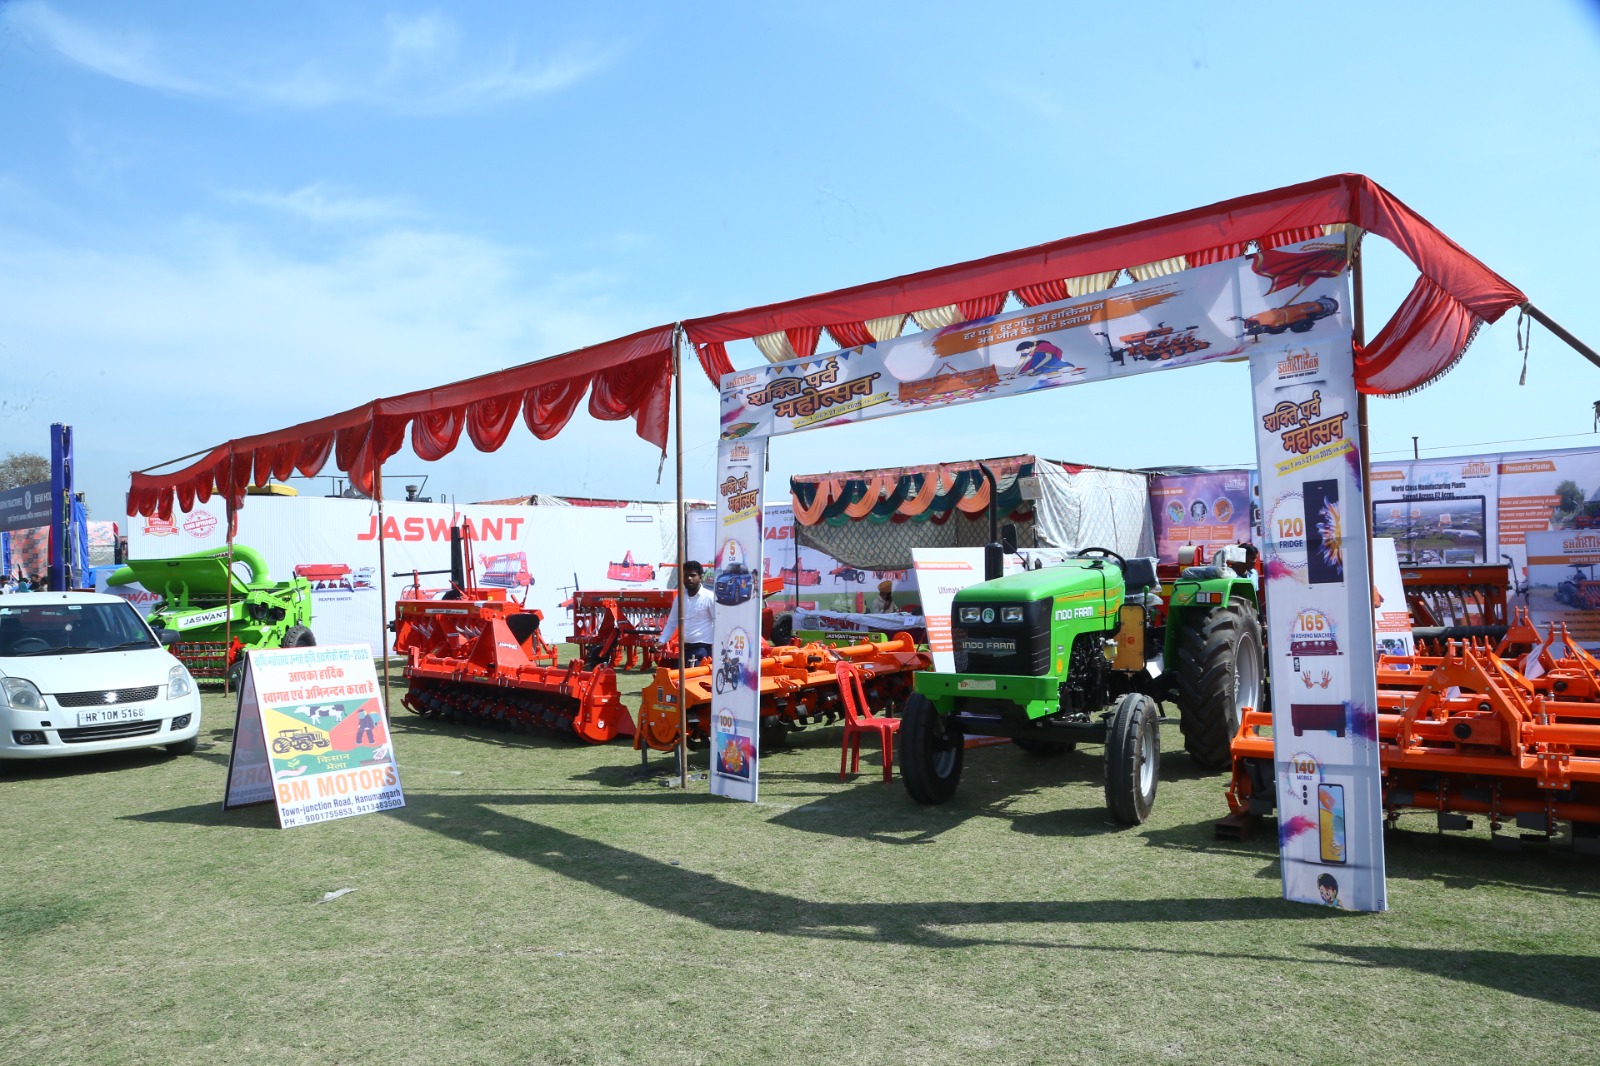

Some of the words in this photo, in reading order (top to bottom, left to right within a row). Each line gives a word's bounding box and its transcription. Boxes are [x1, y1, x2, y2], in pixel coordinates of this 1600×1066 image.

[964, 332, 976, 340] हर
[999, 323, 1012, 332] हर
[1039, 313, 1050, 322] में
[978, 335, 994, 344] अब
[1021, 326, 1034, 335] ढेर
[1060, 313, 1092, 327] इनाम
[1278, 354, 1319, 373] SHAKTIMAN
[748, 378, 802, 407] शक्ति
[805, 361, 839, 388] पर्व
[1263, 401, 1299, 432] शक्ति
[1299, 390, 1321, 419] पर्व
[1320, 449, 1332, 458] 2025
[1506, 464, 1532, 472] Pneumatic
[1418, 482, 1451, 490] Manufacturing
[1278, 518, 1303, 539] 120
[729, 541, 736, 556] 5
[1279, 540, 1303, 549] FRIDGE
[184, 611, 228, 626] JASWANT
[1055, 609, 1072, 621] INDO
[1074, 606, 1093, 618] FARM
[1299, 614, 1324, 631] 165
[734, 635, 745, 650] 25
[289, 671, 317, 682] आपका
[320, 666, 344, 680] हार्दिक
[263, 691, 289, 704] स्वागत
[291, 687, 303, 701] एवं
[305, 685, 344, 700] अभिनन्दन
[346, 683, 367, 694] करता
[368, 680, 374, 694] है
[86, 712, 97, 722] HR
[102, 711, 118, 720] 10M
[720, 715, 733, 728] 100
[317, 754, 350, 766] किसान
[326, 762, 347, 770] मेला
[1294, 759, 1315, 774] 140
[277, 780, 311, 804] BM
[317, 766, 397, 797] MOTORS
[281, 801, 333, 817] Town-junction
[354, 789, 401, 804] Hanumangarh
[284, 818, 296, 826] PH
[356, 799, 402, 813] 9413483500
